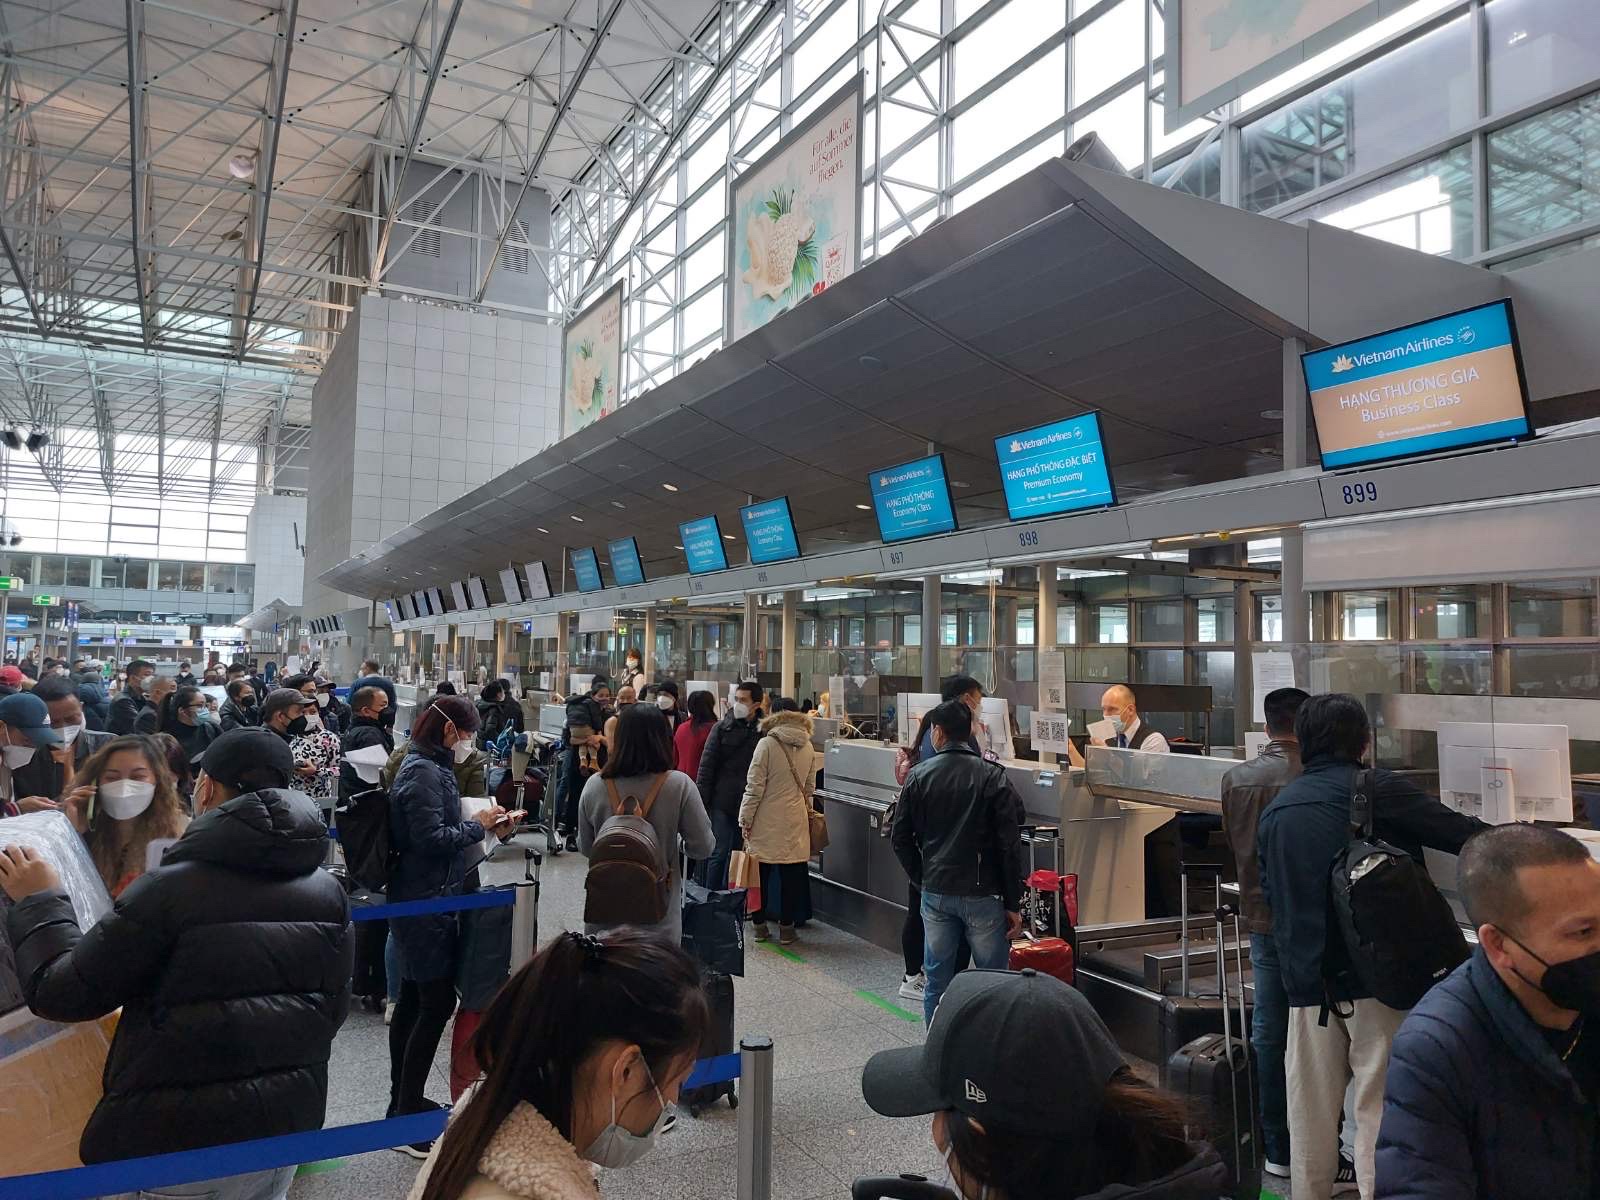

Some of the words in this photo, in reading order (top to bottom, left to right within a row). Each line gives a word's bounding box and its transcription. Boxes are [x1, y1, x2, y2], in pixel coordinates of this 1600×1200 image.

[822, 134, 853, 162] Sommer
[1451, 366, 1480, 385] GIA
[1361, 399, 1421, 423] Business
[1423, 391, 1461, 410] Class
[1023, 478, 1052, 490] Premium
[1052, 471, 1083, 485] Economy
[1342, 481, 1377, 505] 899
[892, 506, 917, 518] Economy
[917, 503, 932, 513] Class
[1019, 530, 1039, 548] 898
[890, 551, 904, 565] 897
